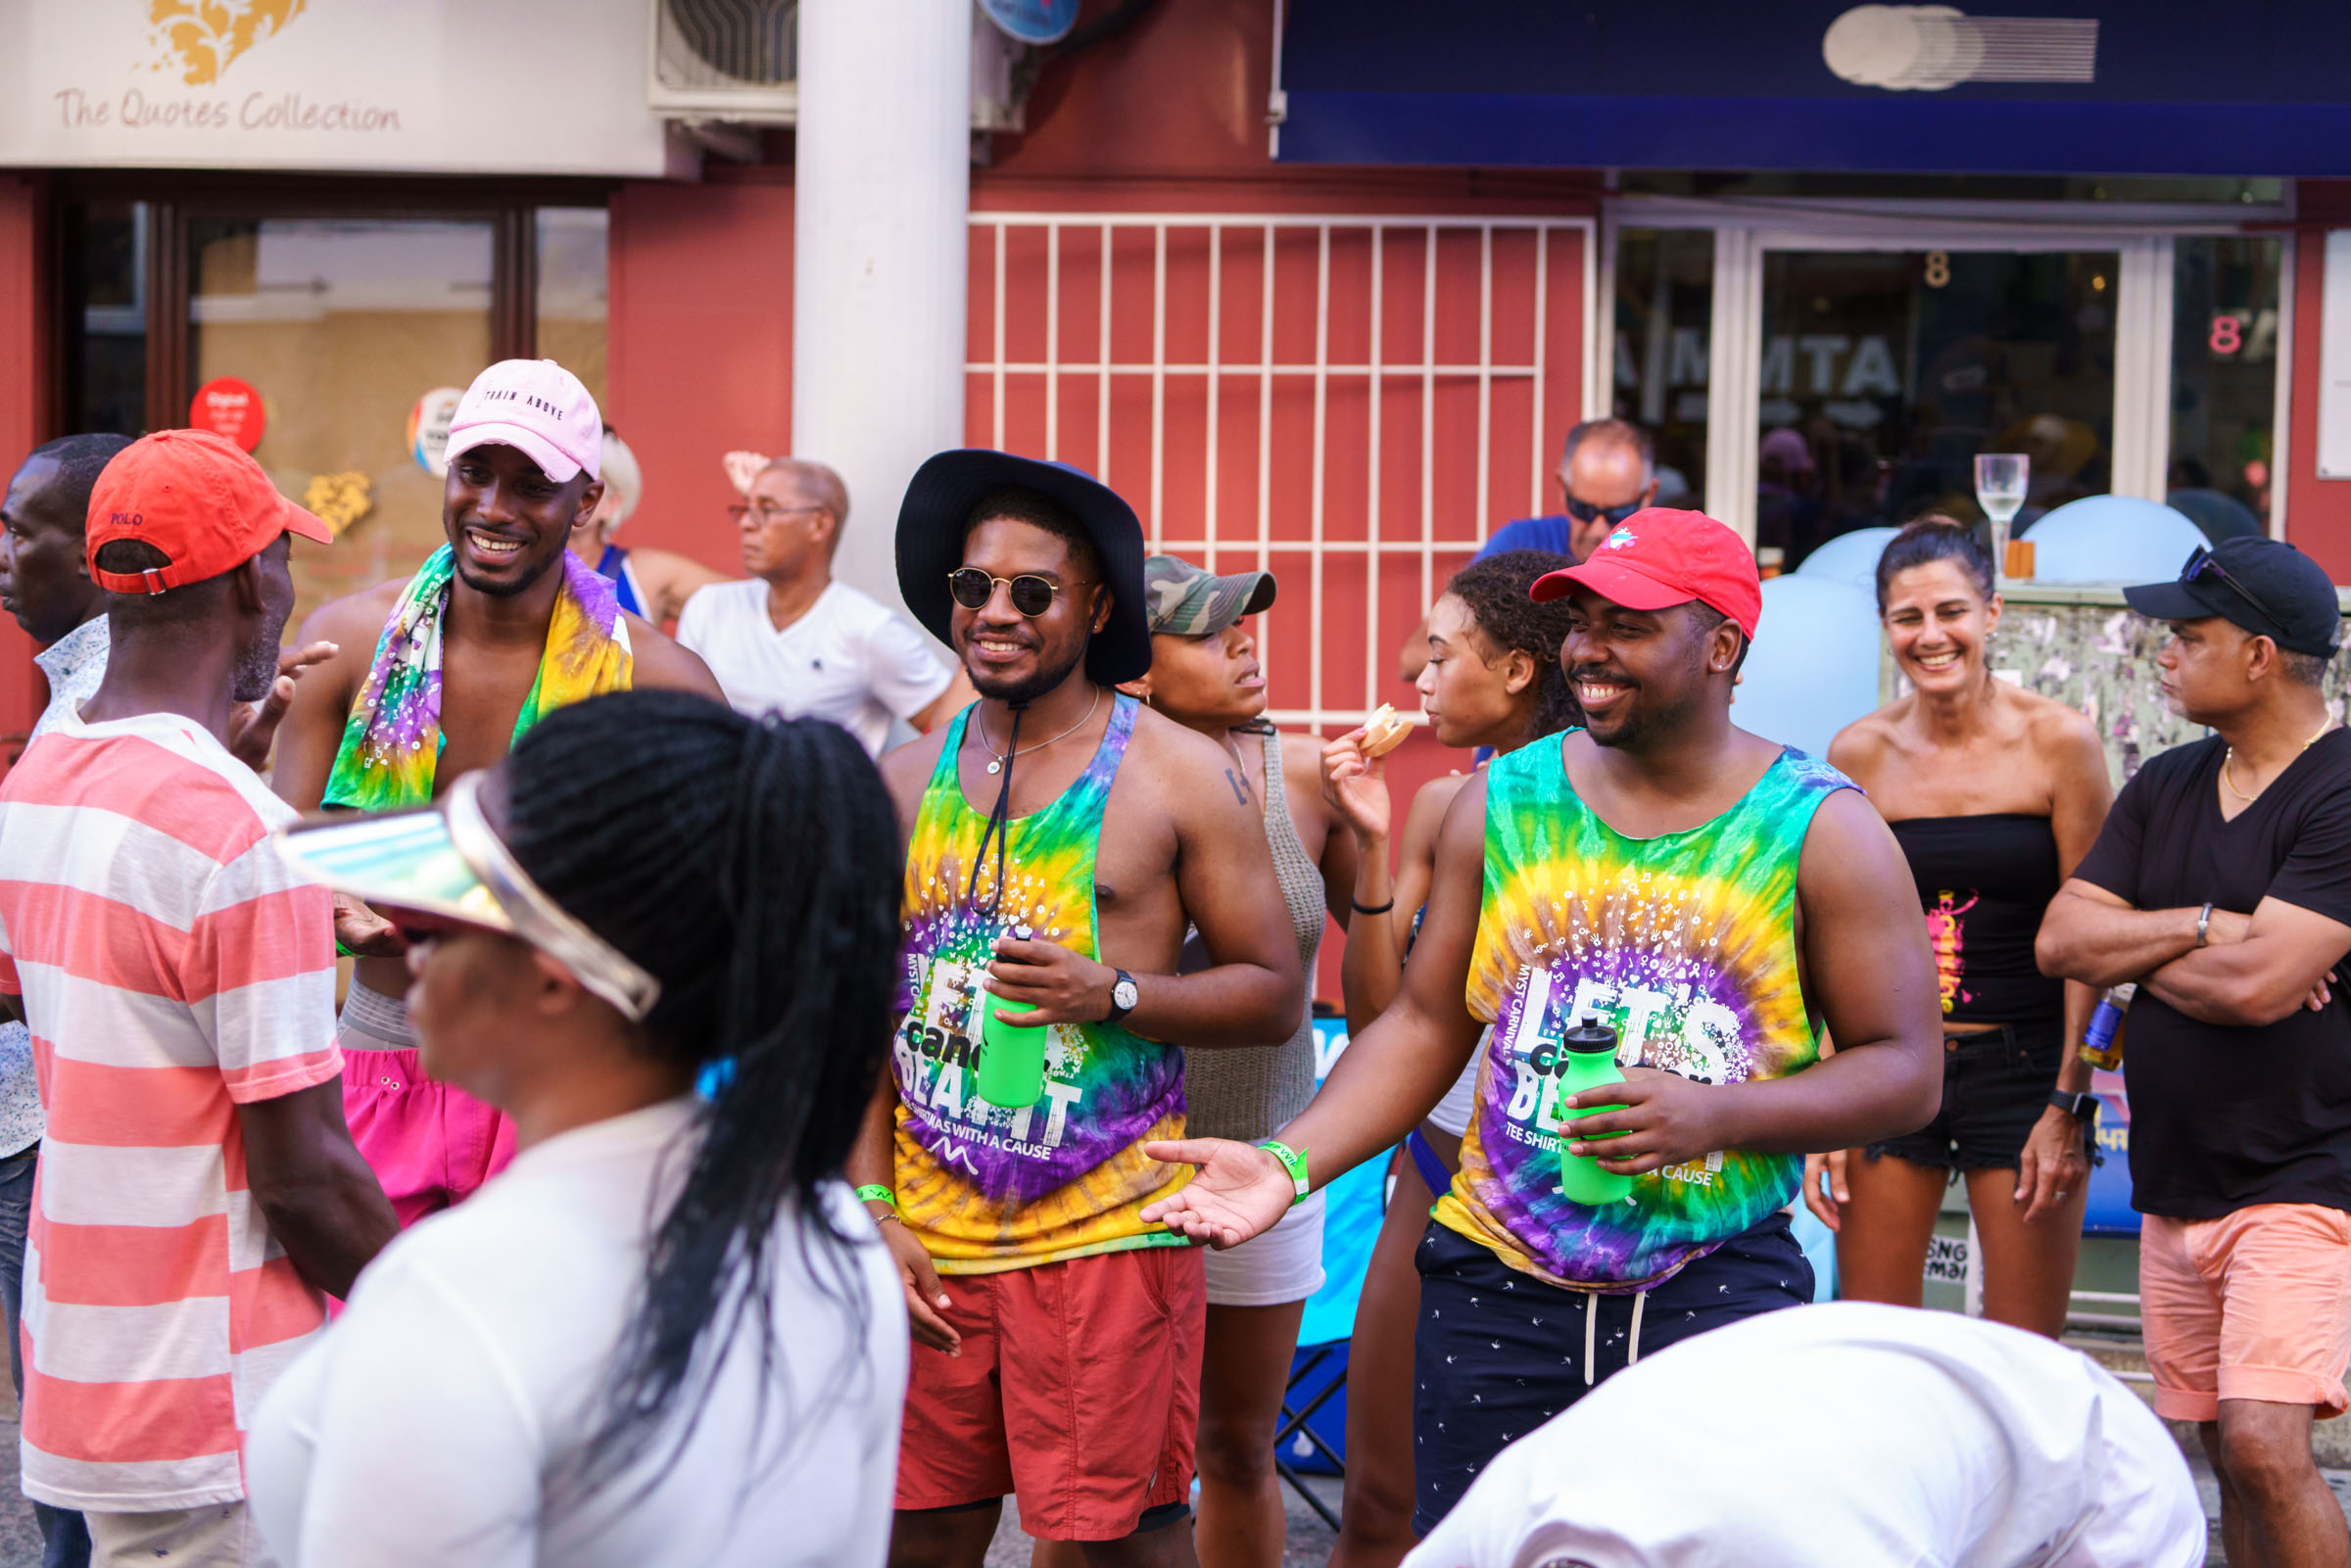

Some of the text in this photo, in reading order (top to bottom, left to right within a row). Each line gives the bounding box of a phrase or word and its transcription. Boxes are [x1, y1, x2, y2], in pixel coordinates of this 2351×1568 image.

[54, 88, 402, 132] The Quotes Collection
[1925, 251, 1950, 288] 8
[2209, 314, 2241, 354] 8
[527, 395, 563, 421] ABOVE
[111, 512, 143, 526] POLO
[907, 953, 920, 986] MYST
[1503, 964, 1531, 1057] MYST CARNIVAL
[952, 1122, 988, 1145] WITH
[989, 1136, 999, 1149] A
[1002, 1138, 1052, 1161] CAUSE
[1506, 1120, 1524, 1142] TEE
[1661, 1164, 1713, 1186] CAUSE
